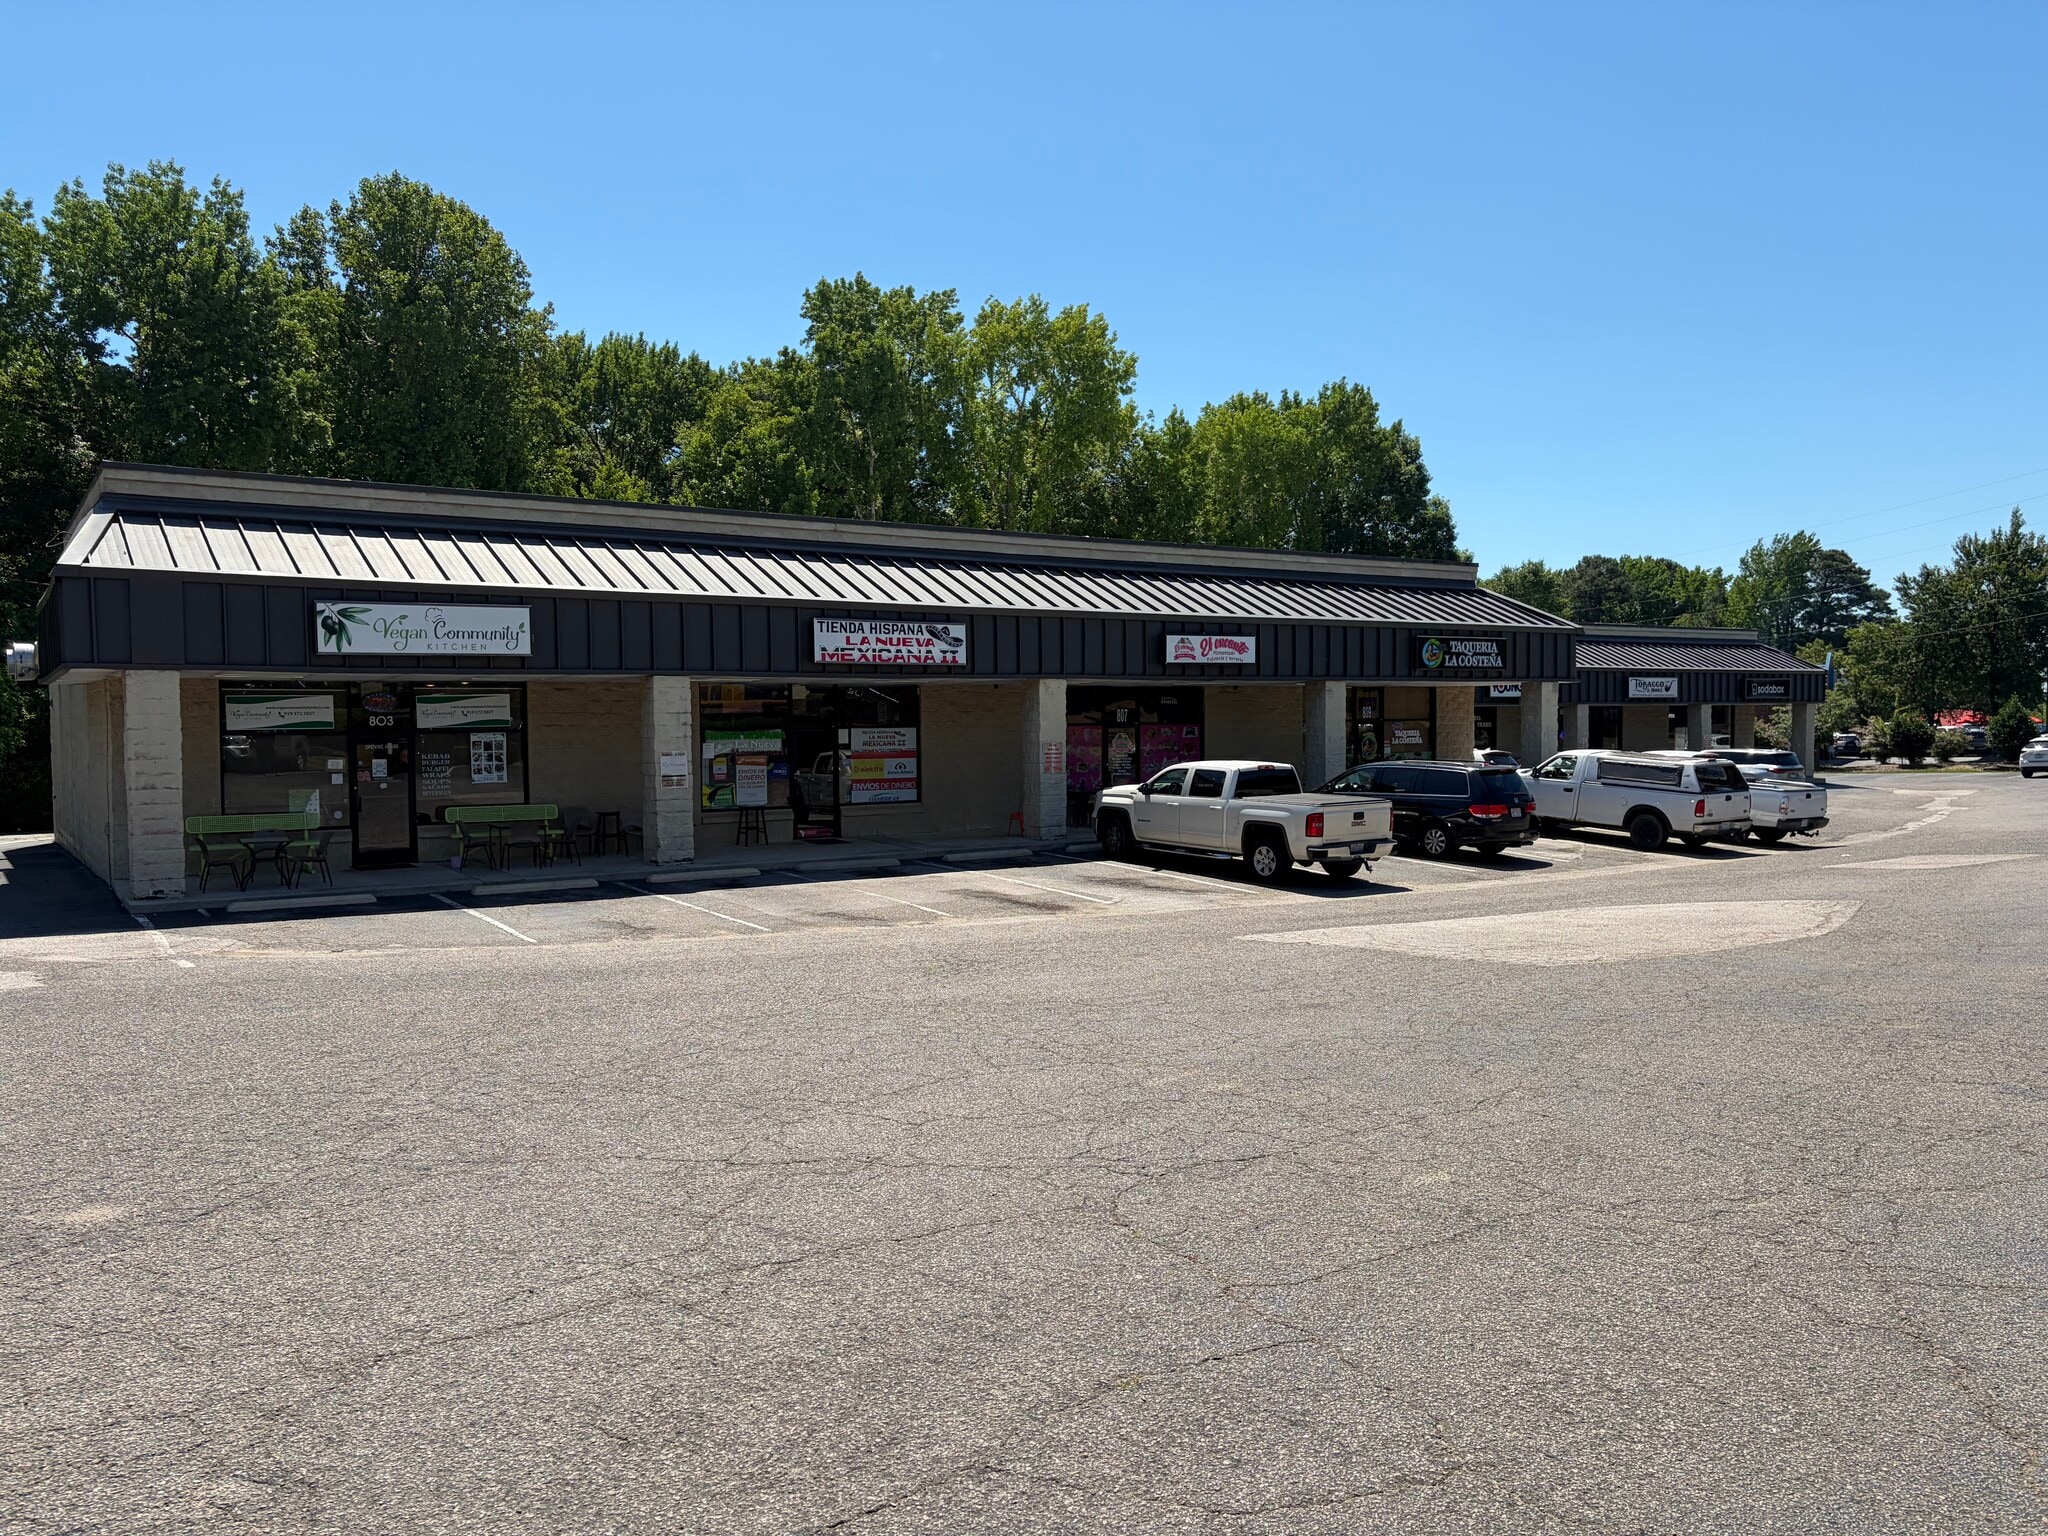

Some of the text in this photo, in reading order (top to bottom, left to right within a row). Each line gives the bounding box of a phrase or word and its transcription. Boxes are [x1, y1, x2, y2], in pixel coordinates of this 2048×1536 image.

[373, 616, 520, 651] Vegan Community
[817, 621, 925, 636] TIENDA HISPANA
[427, 643, 487, 651] KITCHEN
[846, 636, 936, 648] LA NUEVA
[1450, 640, 1498, 655] TAQUERIA
[820, 646, 959, 664] MEXICANA II
[1444, 653, 1503, 667] LA COSTEÑA
[1757, 684, 1785, 694] sodabox
[369, 715, 394, 726] 803
[1116, 708, 1128, 722] 807
[853, 781, 916, 790] ENVÍOS DE DINERO
